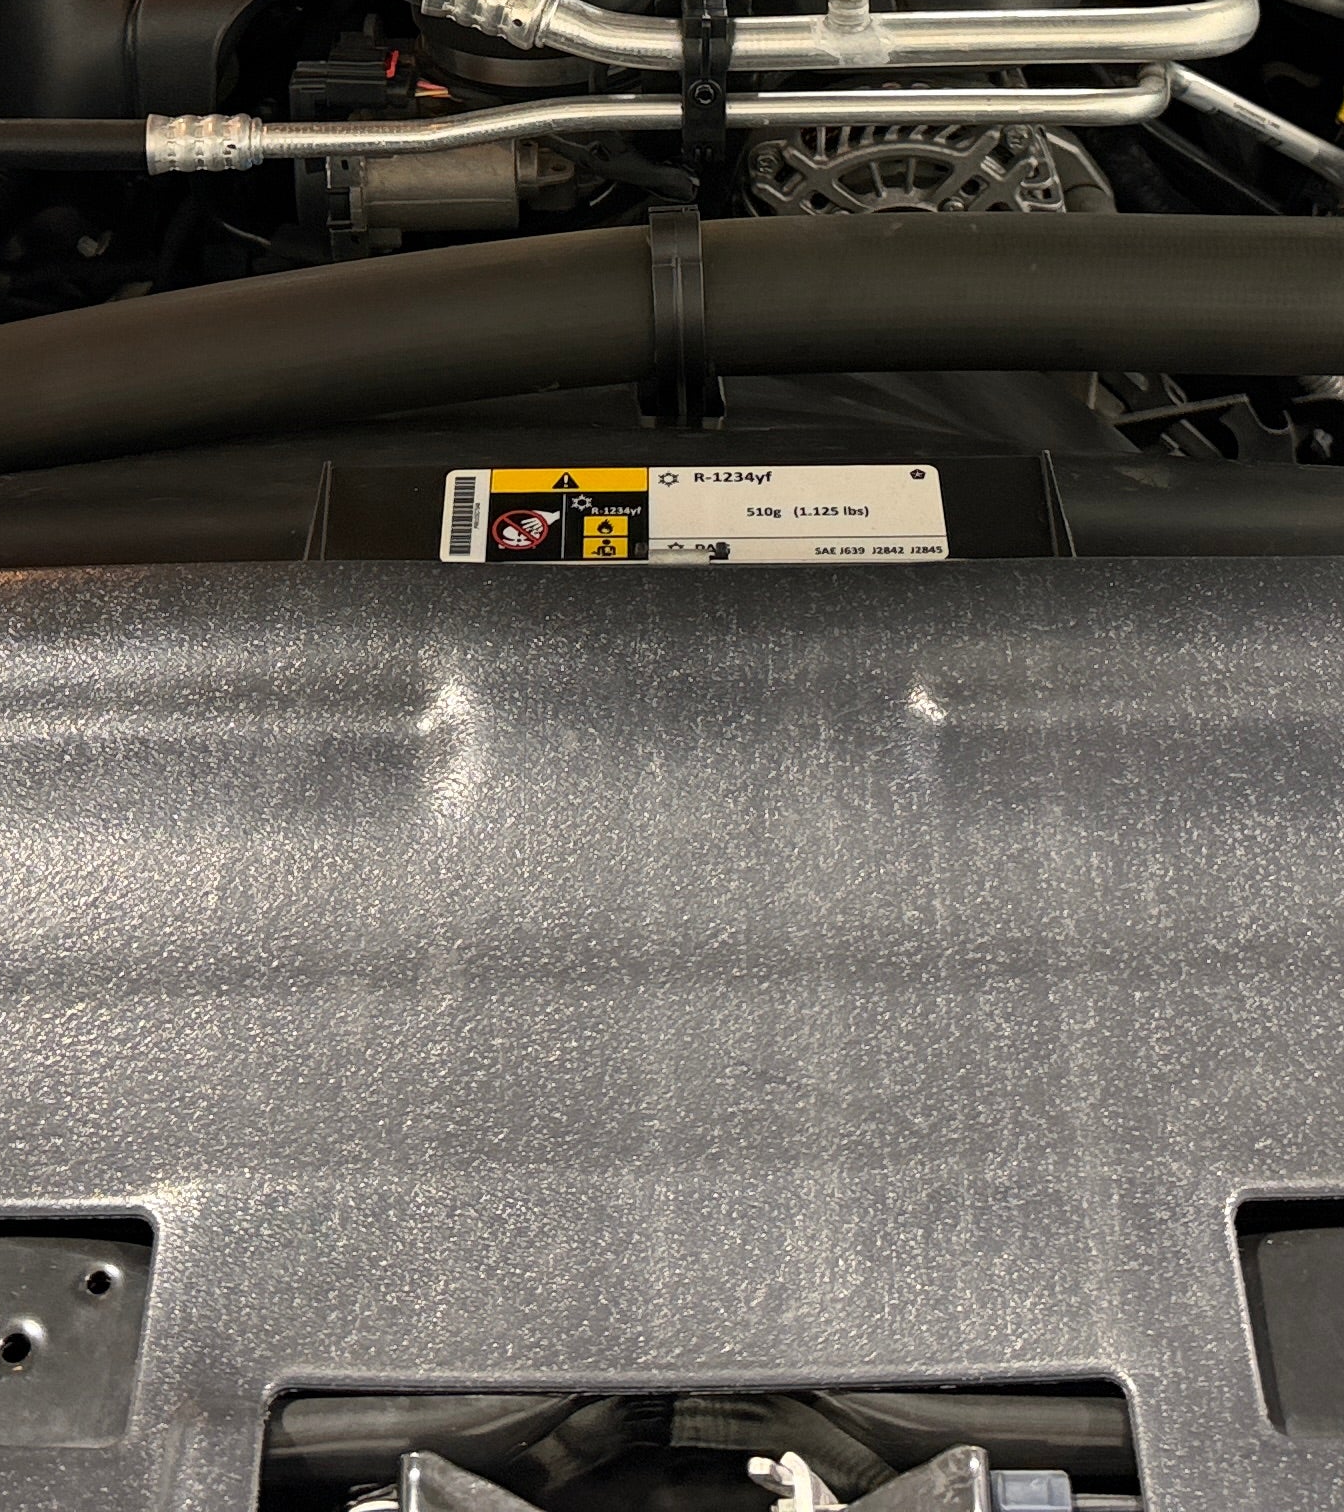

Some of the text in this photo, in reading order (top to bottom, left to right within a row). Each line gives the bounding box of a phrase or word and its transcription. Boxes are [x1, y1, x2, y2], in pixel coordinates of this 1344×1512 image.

[693, 470, 773, 483] R-1234yf
[591, 506, 643, 516] R-1234yf
[746, 505, 870, 519] 510g (1.125 lbs)
[814, 545, 944, 556] SAE J639 J2842 J2845
